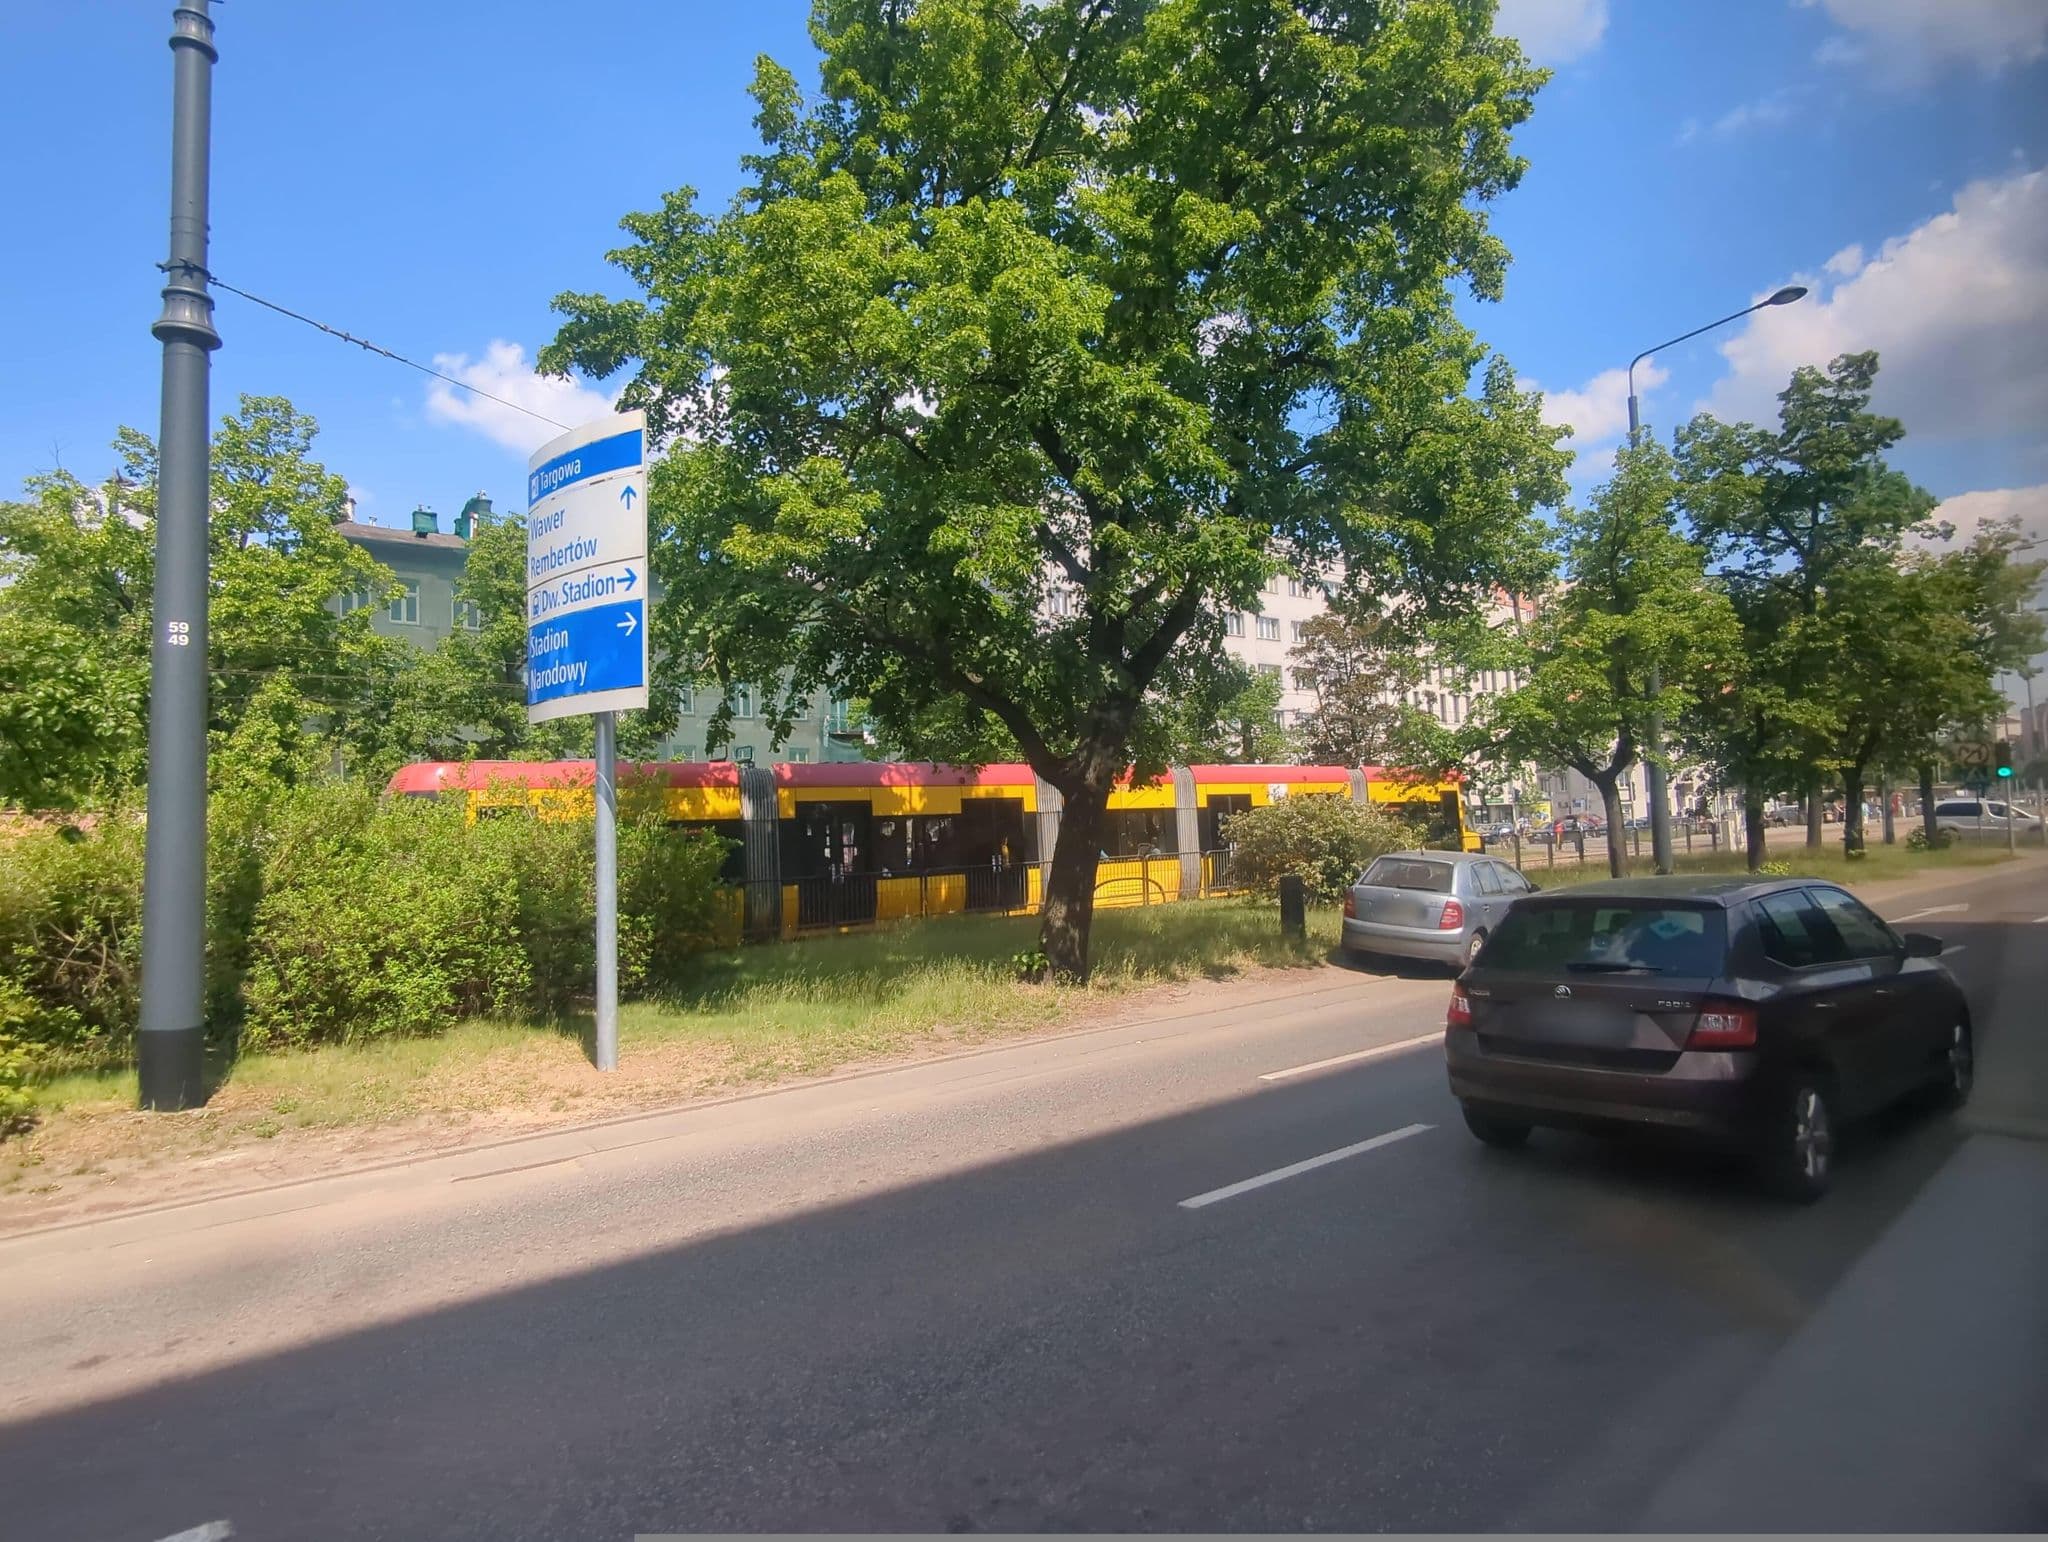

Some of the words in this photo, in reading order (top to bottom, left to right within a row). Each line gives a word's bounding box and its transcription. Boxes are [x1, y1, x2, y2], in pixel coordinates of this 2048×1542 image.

[540, 459, 581, 491] Targowa
[530, 508, 565, 541] Wawer
[530, 535, 598, 579] Rembertów
[541, 589, 560, 613] Dw.
[562, 573, 615, 606] Stadion
[168, 621, 189, 633] 59
[168, 634, 189, 646] 49
[530, 627, 568, 658] Stadion
[530, 659, 588, 692] Narodowy
